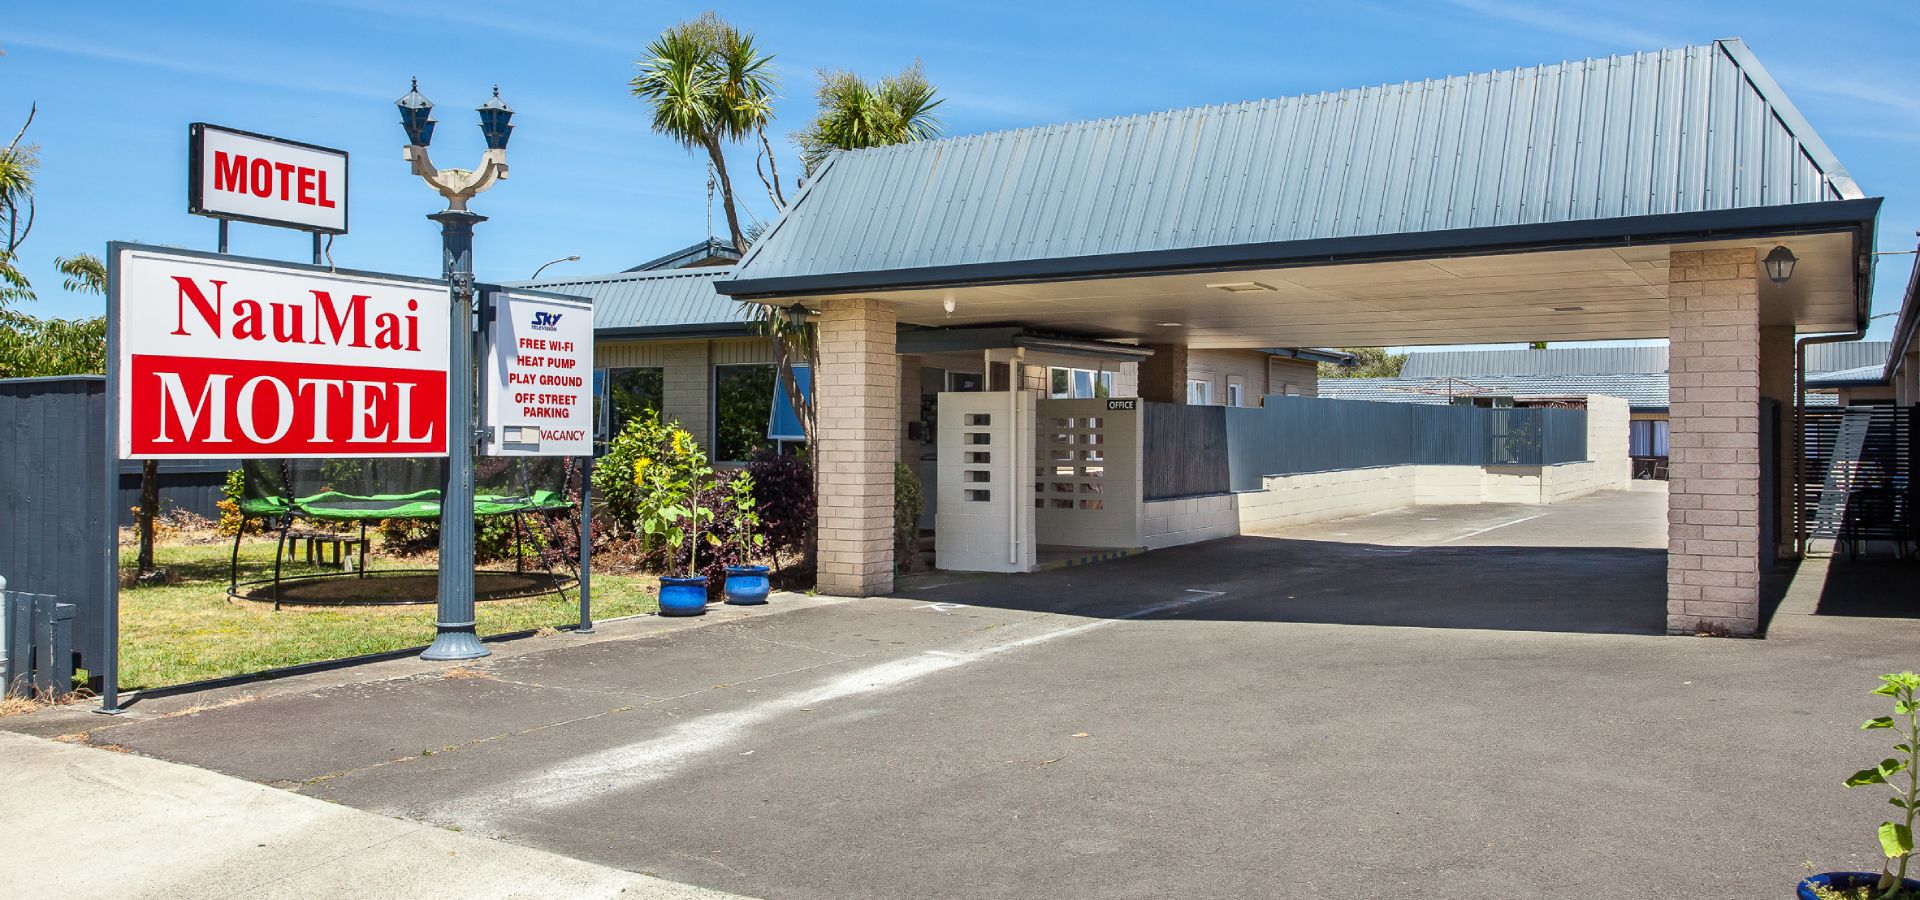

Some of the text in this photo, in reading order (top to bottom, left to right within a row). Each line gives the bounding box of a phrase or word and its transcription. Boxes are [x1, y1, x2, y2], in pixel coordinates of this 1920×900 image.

[214, 151, 336, 209] MOTEL
[170, 276, 422, 352] NauMai
[531, 312, 563, 326] SKY
[519, 338, 574, 352] FREE WI-FI
[516, 355, 576, 369] HEAT PUMP
[509, 373, 583, 387] PLAY GROUND
[515, 392, 577, 405] OFF STREET
[1109, 401, 1134, 409] OFFICE
[152, 372, 433, 444] MOTEL
[523, 407, 570, 419] PARKING
[540, 430, 585, 441] VACANCY
